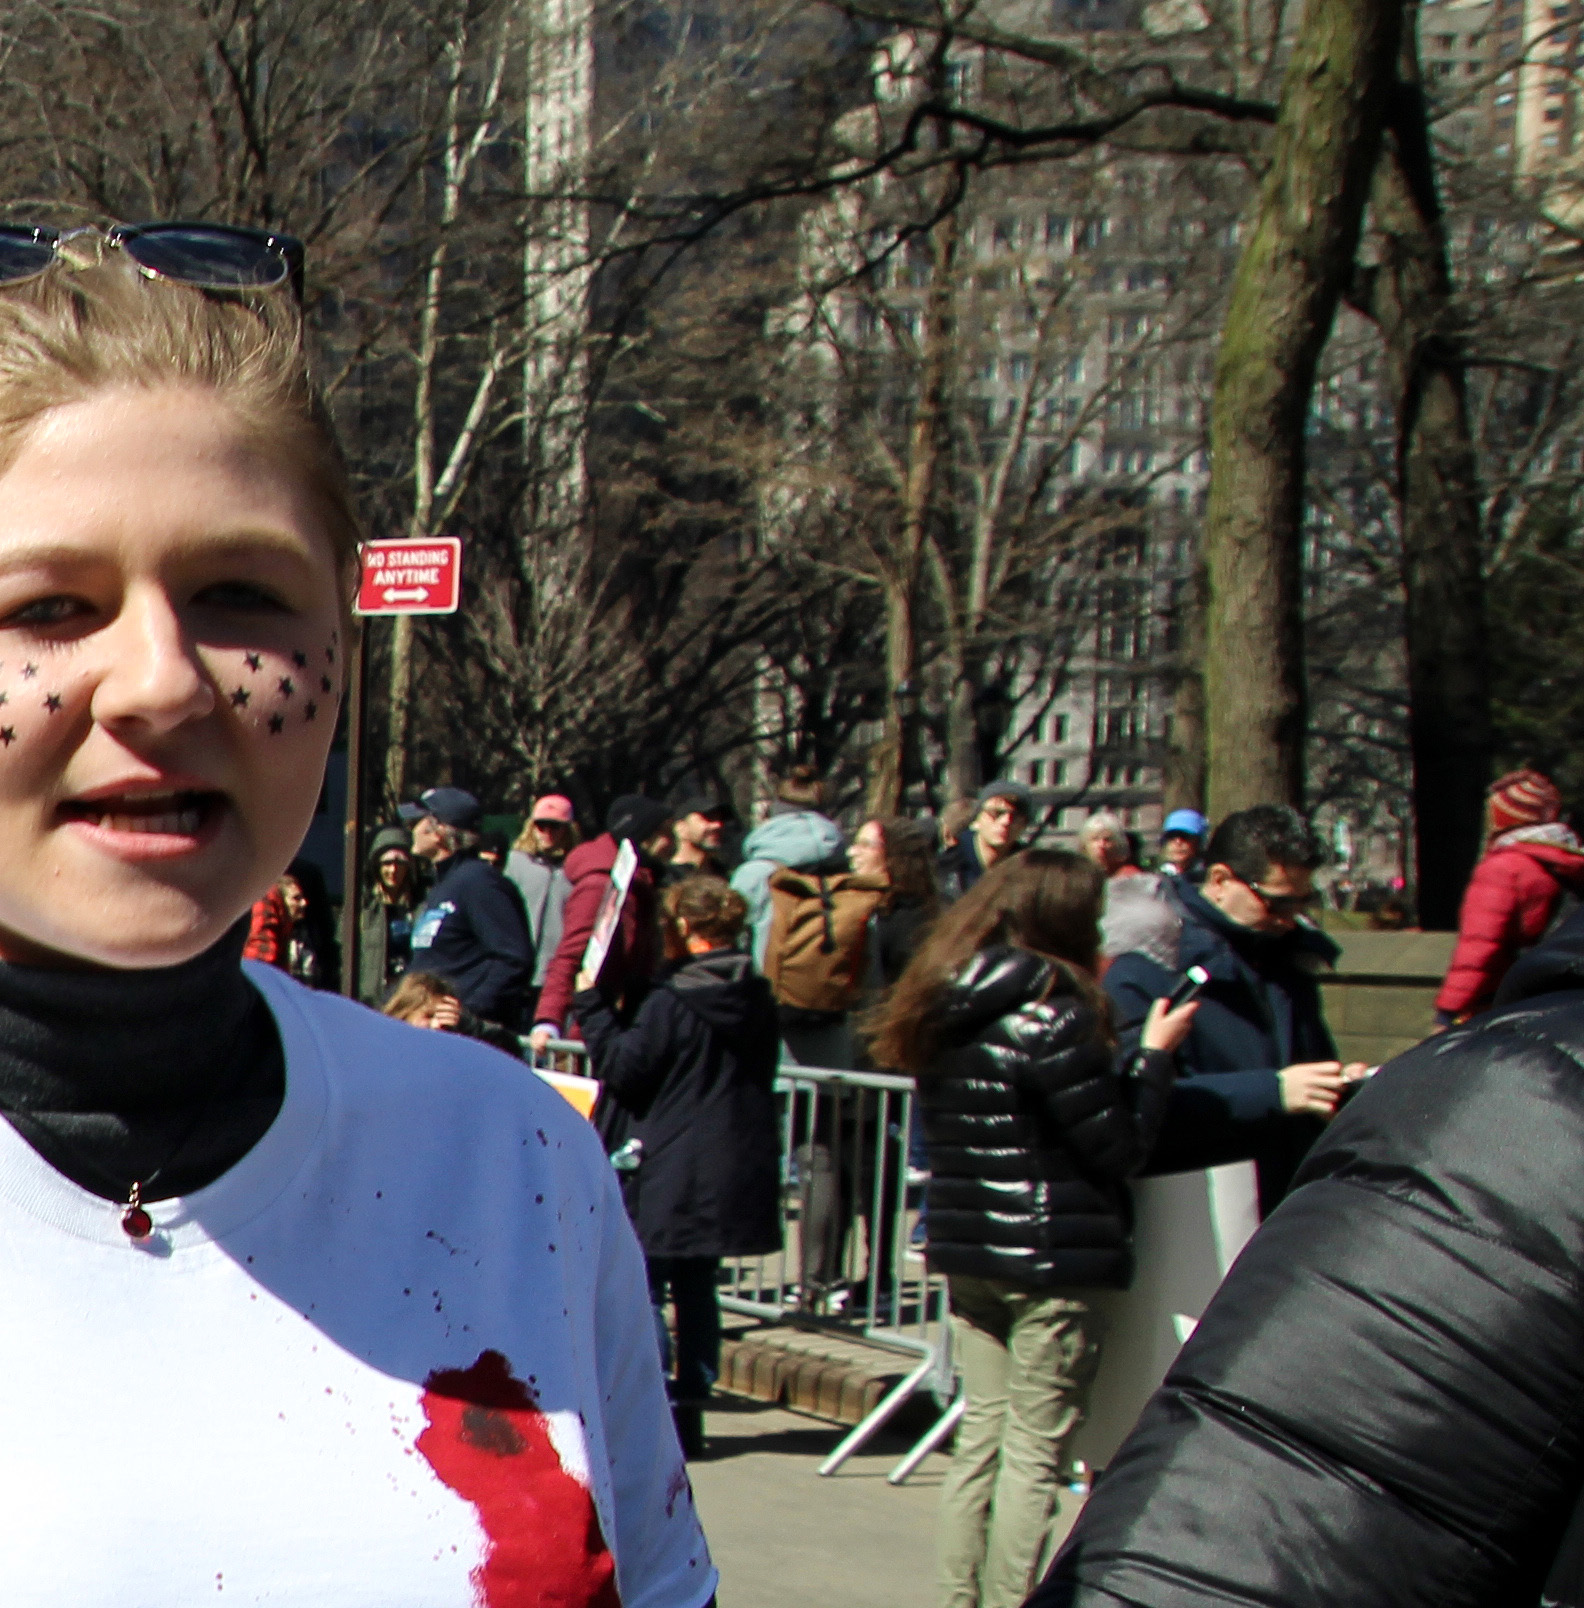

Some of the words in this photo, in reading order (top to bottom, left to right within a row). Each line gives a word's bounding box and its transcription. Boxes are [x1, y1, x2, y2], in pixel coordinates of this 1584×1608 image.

[366, 550, 386, 568] NO
[387, 548, 450, 567] STANDING
[372, 567, 441, 586] ANYTIME
